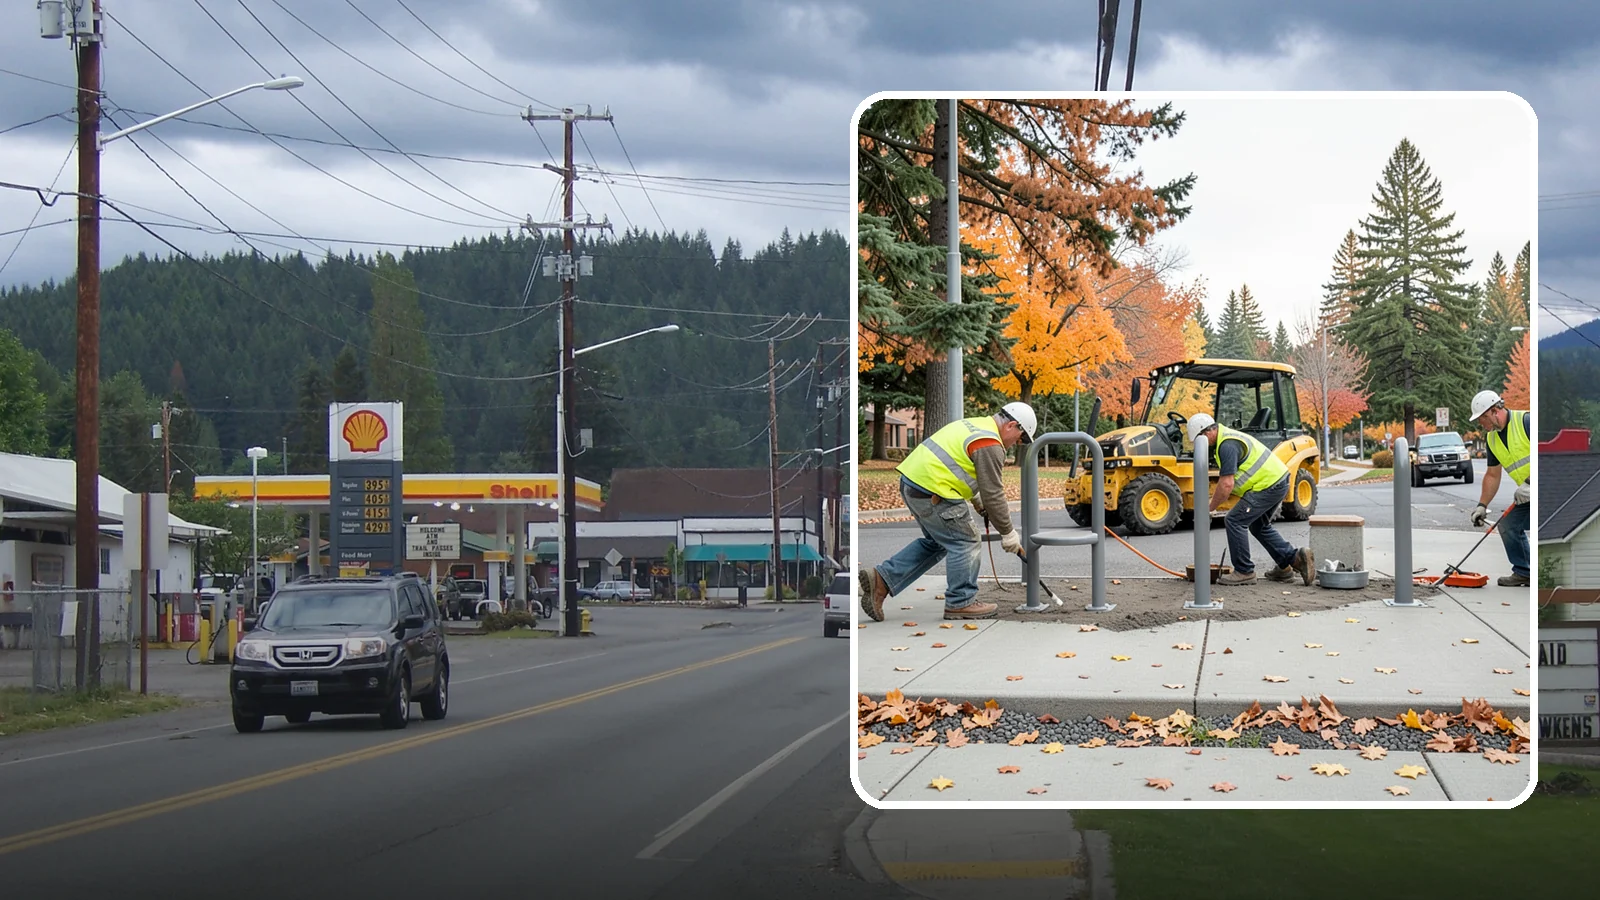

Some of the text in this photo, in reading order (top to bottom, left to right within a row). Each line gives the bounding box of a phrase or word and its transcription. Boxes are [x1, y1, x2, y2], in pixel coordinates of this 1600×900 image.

[365, 480, 384, 490] 395
[490, 484, 547, 498] Shell
[365, 494, 384, 504] 405
[365, 508, 383, 518] 415
[365, 522, 384, 533] 429
